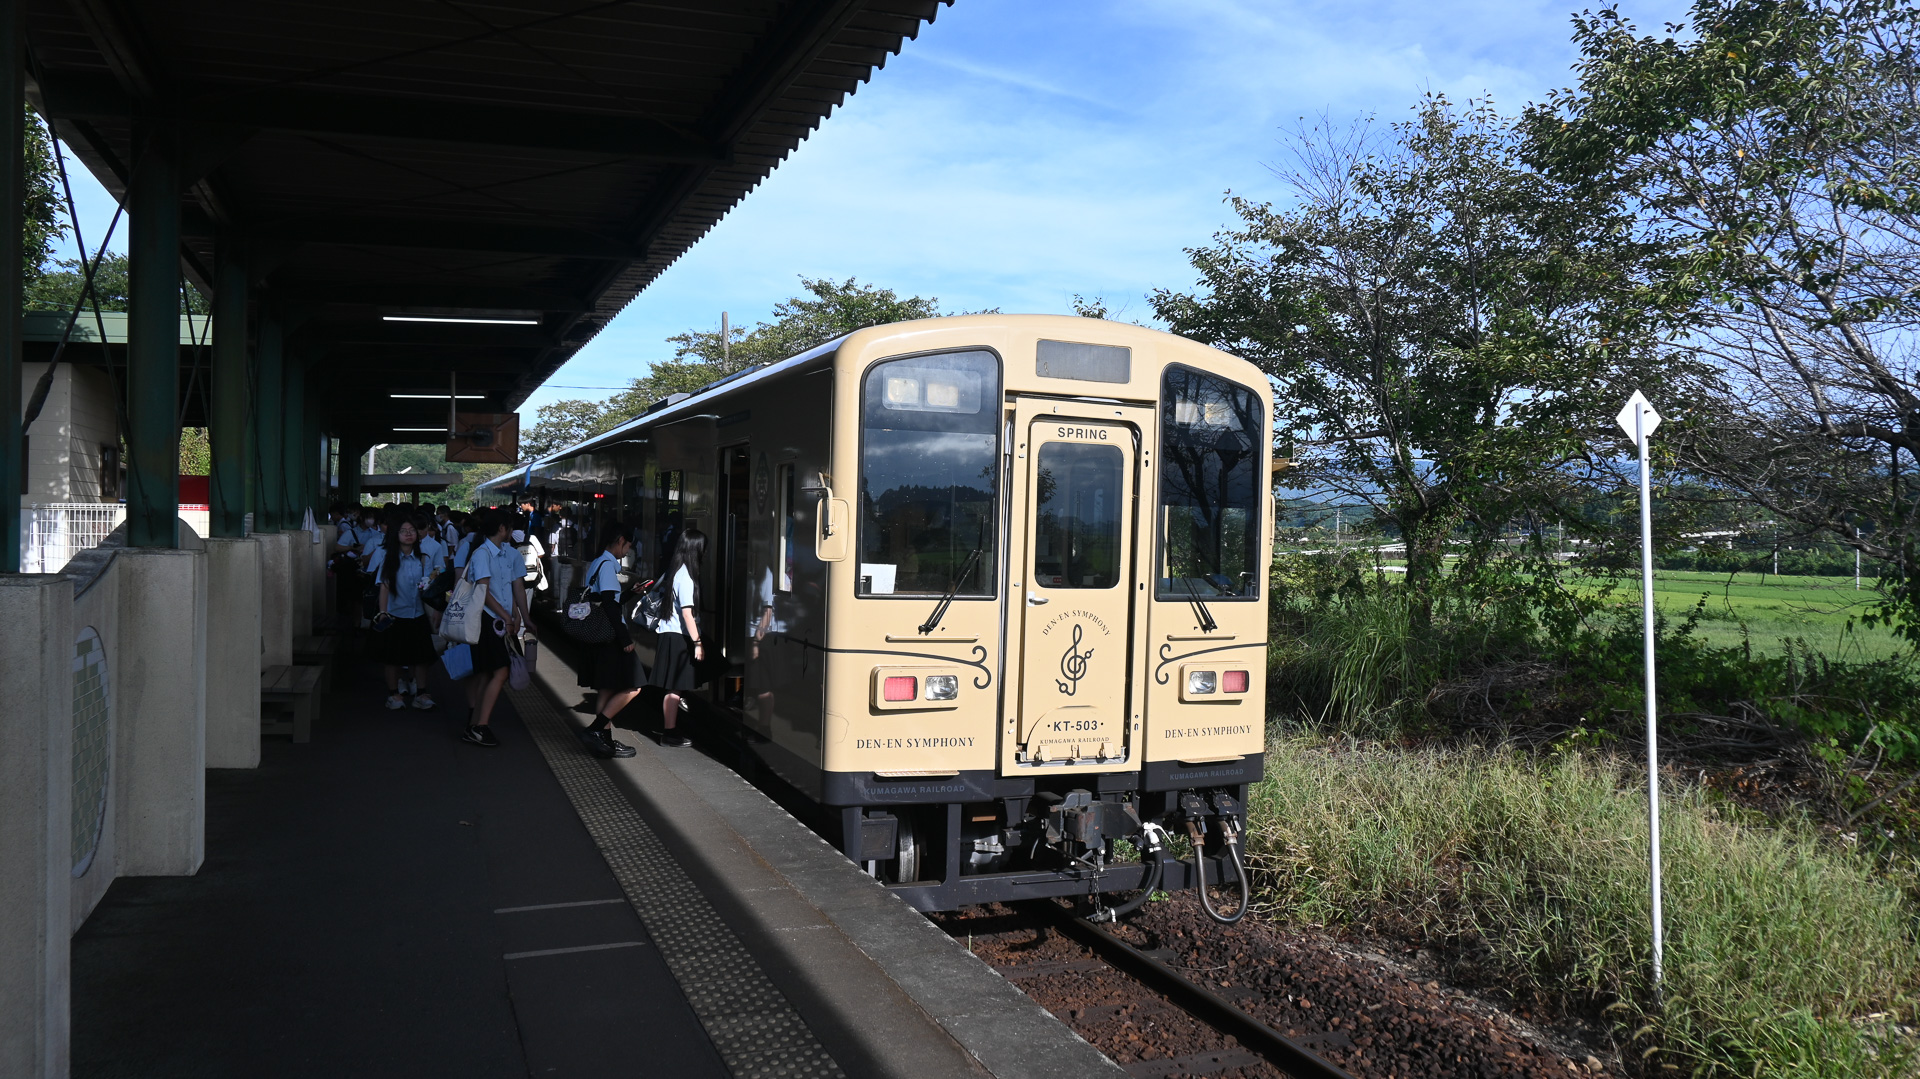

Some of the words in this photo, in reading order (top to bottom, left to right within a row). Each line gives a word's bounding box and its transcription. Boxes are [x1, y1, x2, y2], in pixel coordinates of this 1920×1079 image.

[1058, 427, 1107, 440] SPRING
[1042, 611, 1070, 636] DEN-EN
[1072, 610, 1111, 636] SYMPHONY
[1165, 728, 1199, 739] DEN-EN
[1201, 725, 1252, 737] SYMPHONY
[856, 738, 902, 749] DEN-EN
[906, 737, 975, 748] SYMPHONY
[1169, 771, 1209, 780] KUMAGAWA
[1210, 768, 1244, 777] RAILROAD
[864, 786, 917, 796] KUMAGAWA
[919, 785, 965, 794] RAILROAD
